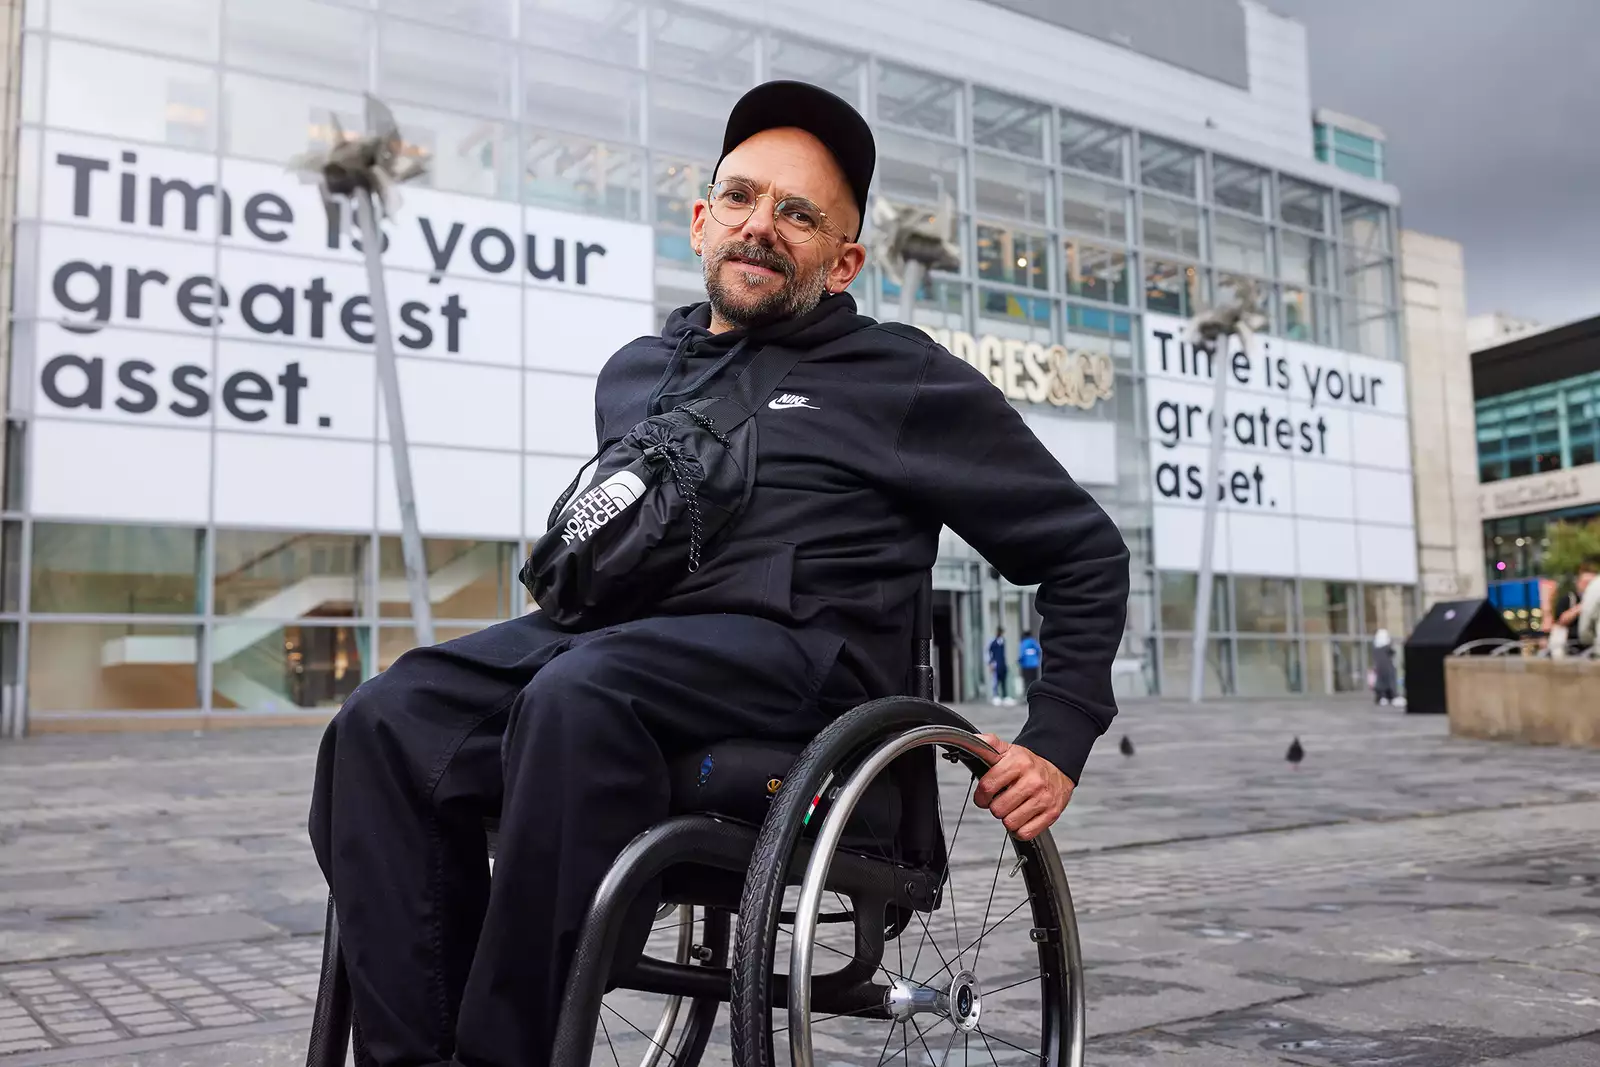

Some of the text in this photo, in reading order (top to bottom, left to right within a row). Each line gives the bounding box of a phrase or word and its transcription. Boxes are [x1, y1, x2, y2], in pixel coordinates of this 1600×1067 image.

[57, 151, 294, 242] Time
[418, 216, 607, 286] your
[52, 260, 468, 353] greatest
[41, 353, 332, 428] asset.
[777, 393, 810, 405] NIKE
[1265, 342, 1290, 390] is
[1302, 362, 1382, 408] your
[561, 492, 612, 546] NORTH
[568, 487, 603, 512] THE
[578, 501, 620, 542] FACE
